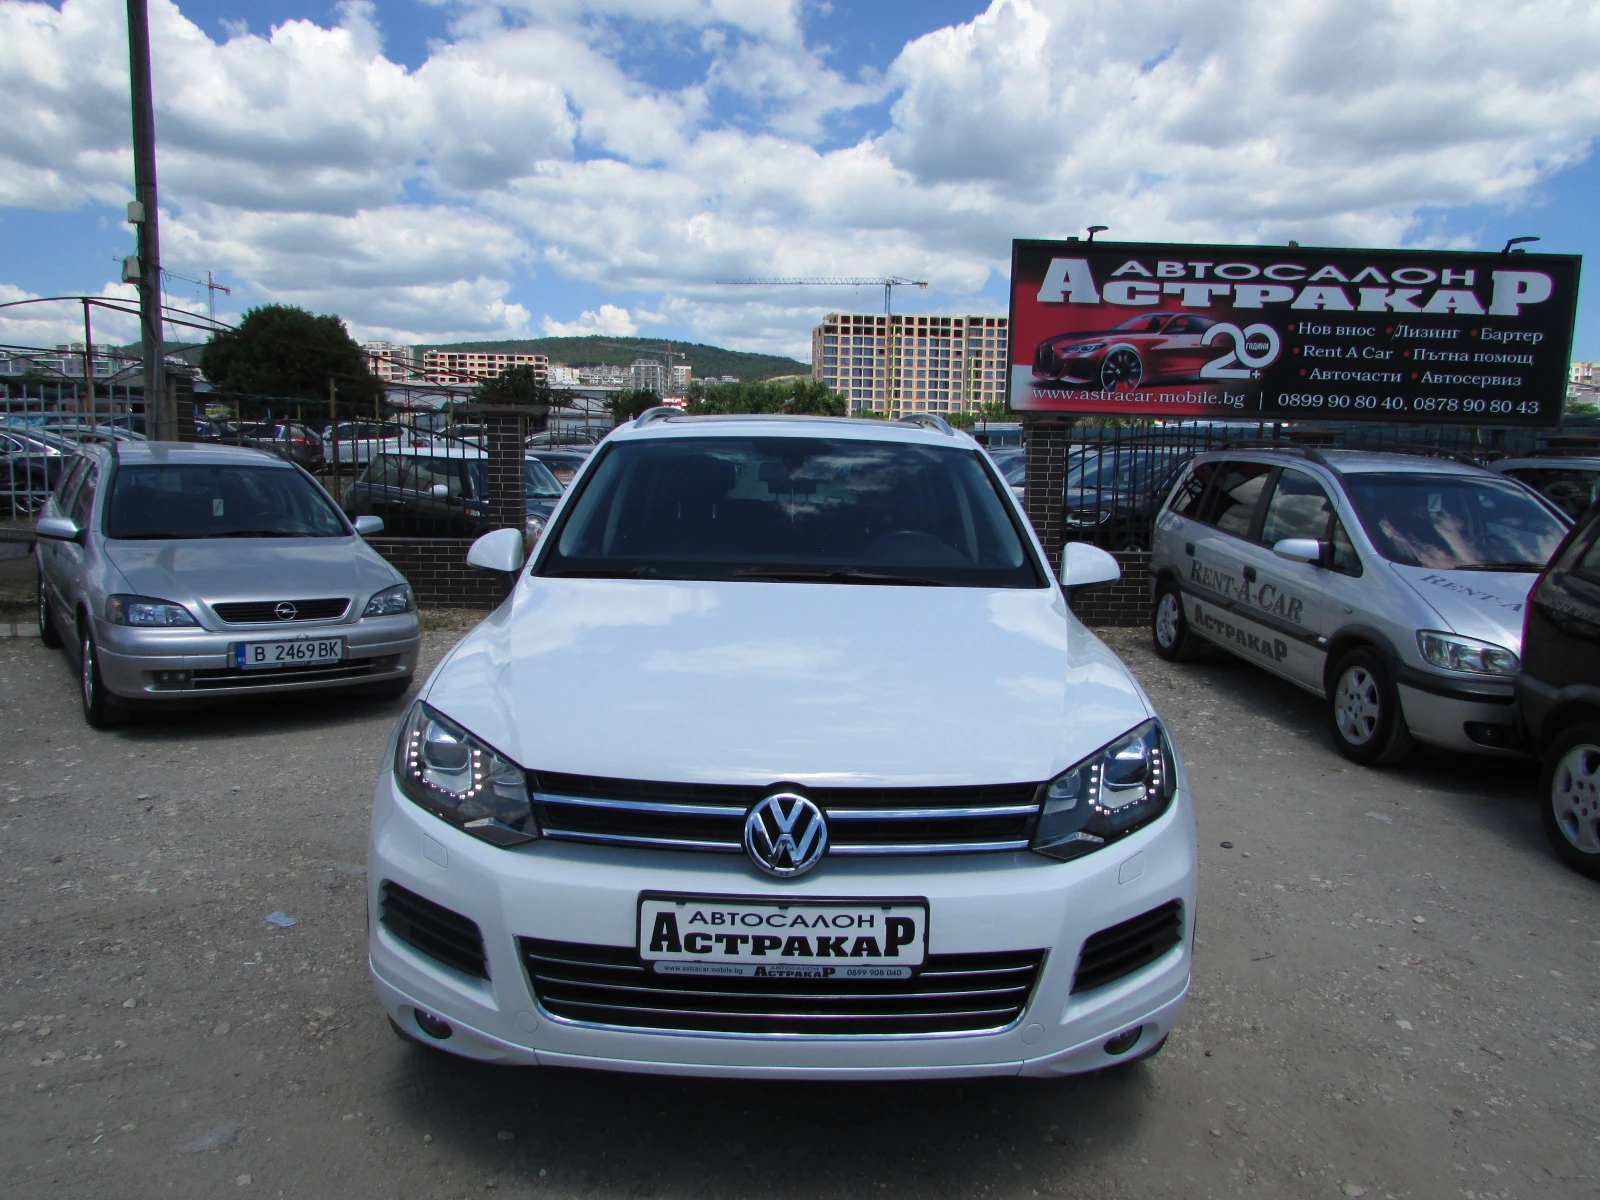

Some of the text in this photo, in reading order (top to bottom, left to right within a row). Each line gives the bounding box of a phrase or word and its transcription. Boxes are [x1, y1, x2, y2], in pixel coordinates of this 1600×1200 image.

[1110, 260, 1475, 287] АВТОСАЛОН
[1036, 257, 1553, 316] АСТРАКАР
[1297, 321, 1376, 337] Нов внос
[1394, 324, 1461, 340] Лизинг
[1479, 327, 1544, 345] Бартер
[1302, 345, 1394, 360] Rent A Car
[1412, 348, 1535, 366] Пътна помощ
[1308, 367, 1402, 382] Авточасти
[1420, 371, 1522, 388] Автосервиз
[1032, 388, 1245, 408] www.astracar.mobile.bg
[1278, 393, 1323, 408] 0899
[1327, 394, 1350, 409] 90
[1354, 395, 1377, 410] 80
[1413, 397, 1459, 412] 0878
[1463, 398, 1486, 413] 90
[1489, 399, 1512, 414] 80
[1515, 400, 1539, 415] 43
[1190, 559, 1304, 623] RENT-A-CAR
[254, 641, 339, 662] B 2469 BK
[688, 910, 875, 929] АВТОСАЛОН
[649, 911, 916, 957] АСТРАКАР
[846, 968, 902, 977] 0899 908 040
